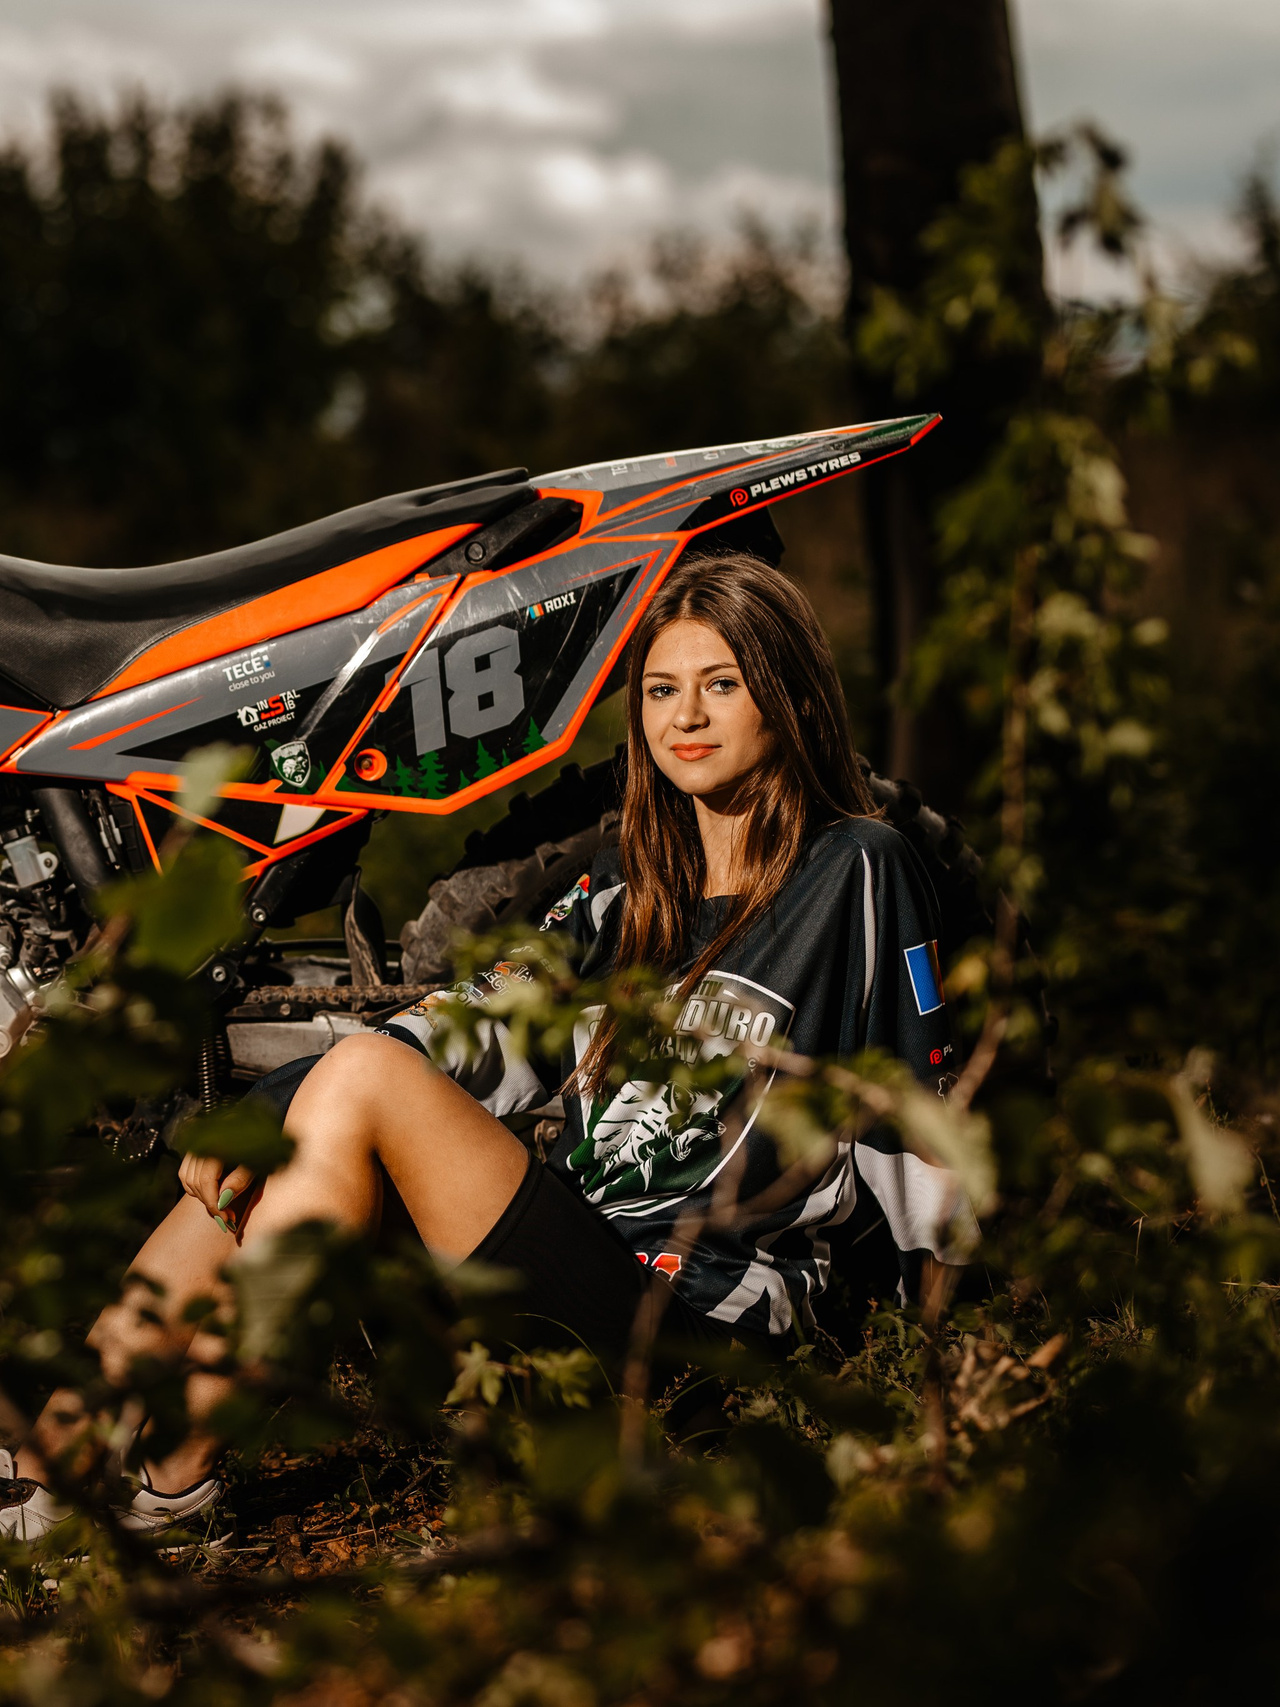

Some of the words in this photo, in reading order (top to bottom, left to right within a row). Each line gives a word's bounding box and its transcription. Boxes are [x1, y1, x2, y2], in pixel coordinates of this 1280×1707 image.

[750, 470, 808, 498] PLEWS
[807, 451, 862, 478] TYRES
[544, 592, 577, 613] ROXI
[222, 657, 265, 682] TECE
[228, 677, 250, 692] close
[250, 674, 260, 684] to
[261, 670, 276, 683] you
[384, 624, 526, 757] 18
[253, 721, 268, 732] GAZ
